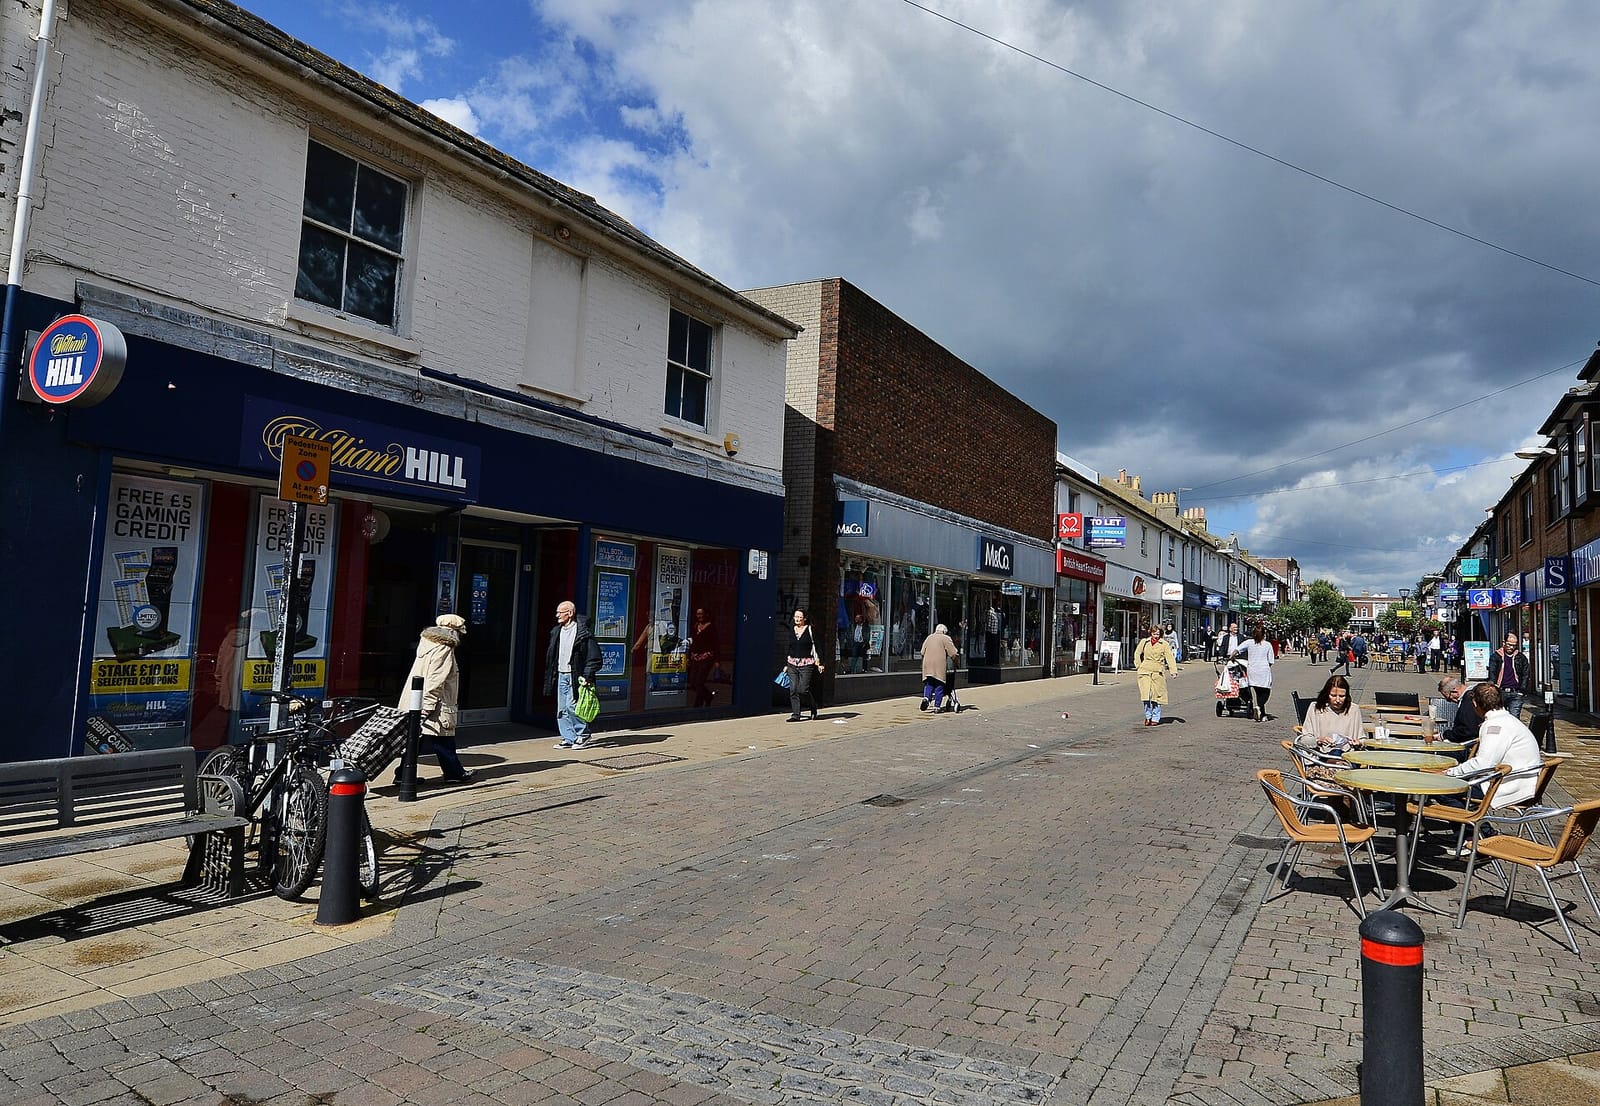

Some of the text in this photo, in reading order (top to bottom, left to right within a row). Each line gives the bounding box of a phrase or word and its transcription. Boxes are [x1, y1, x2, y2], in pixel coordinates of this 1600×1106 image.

[50, 332, 88, 355] William
[44, 356, 83, 387] HILL
[288, 438, 329, 452] Pedestrian
[298, 448, 318, 458] Zone
[405, 446, 467, 489] HILL
[292, 482, 319, 493] At any
[117, 487, 192, 509] FREE £5
[296, 491, 313, 500] time
[116, 502, 191, 525] GAMING
[309, 512, 327, 526] £5
[1090, 518, 1121, 526] TO LET
[114, 519, 190, 541] CREDIT
[267, 521, 325, 540] GANG
[265, 536, 325, 555] CRDIT
[660, 554, 677, 565] FREE
[984, 542, 1010, 571] M&Co.
[660, 564, 687, 575] GAMING
[1063, 556, 1104, 577] British Heart Foundation
[660, 573, 686, 585] CREDIT
[1549, 565, 1565, 587] S
[98, 663, 179, 678] STAKE £10 ON
[304, 663, 317, 674] ON
[97, 675, 178, 687] SELECTED COUPONS
[145, 700, 167, 710] HILL
[86, 716, 111, 737] DEBIT
[86, 731, 101, 746] VISA
